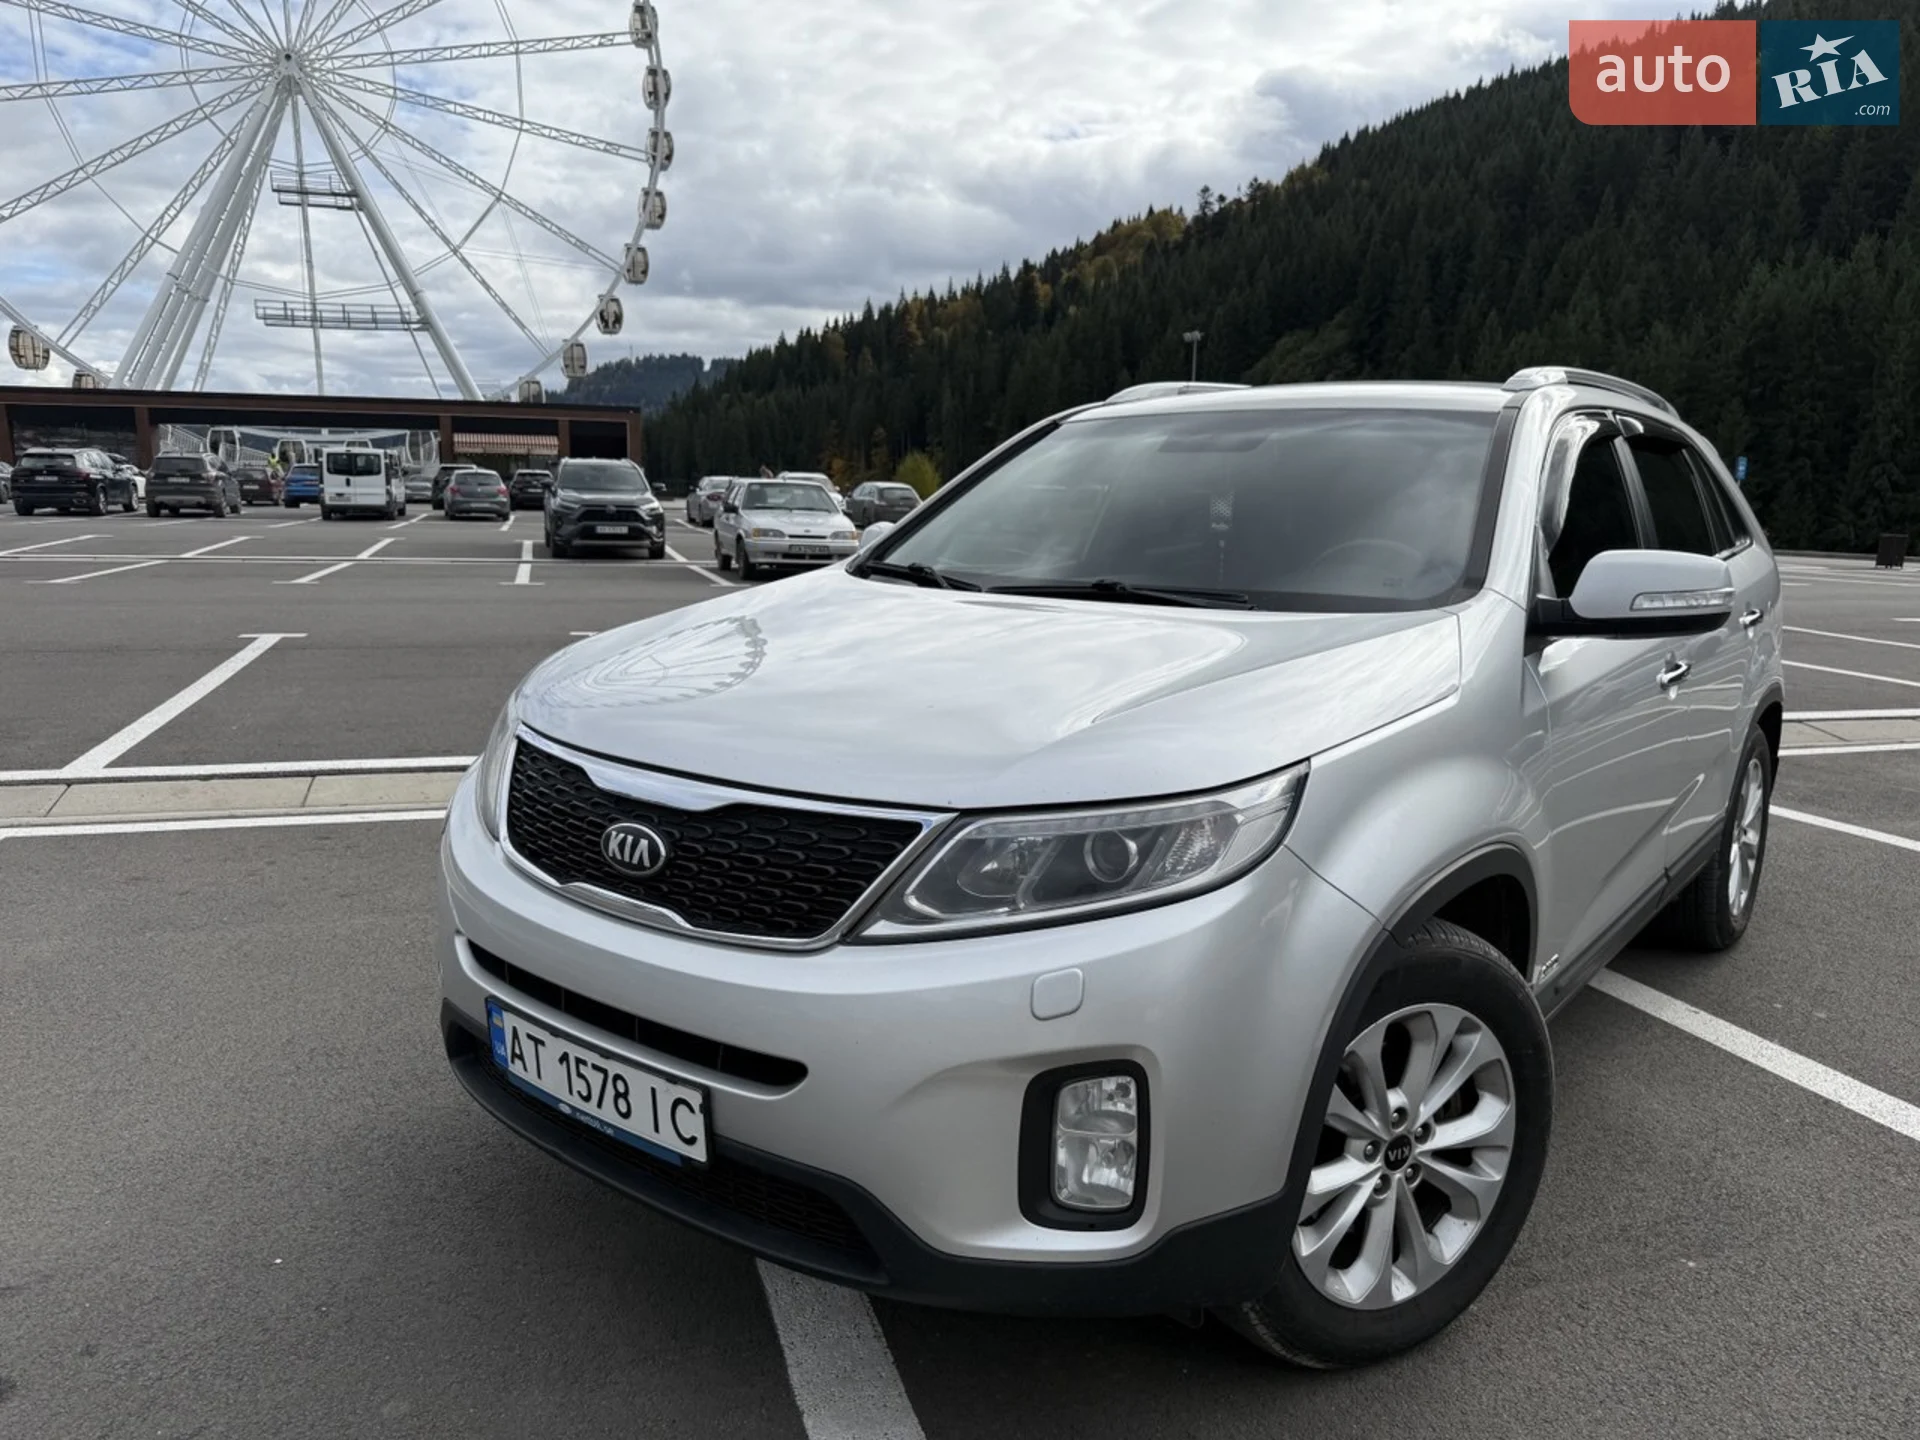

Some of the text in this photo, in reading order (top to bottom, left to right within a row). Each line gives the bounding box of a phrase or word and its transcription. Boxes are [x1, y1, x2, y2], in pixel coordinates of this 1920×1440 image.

[608, 830, 651, 868] KIA
[510, 1025, 546, 1080] AT
[558, 1051, 633, 1120] 1578
[650, 1086, 698, 1146] IC
